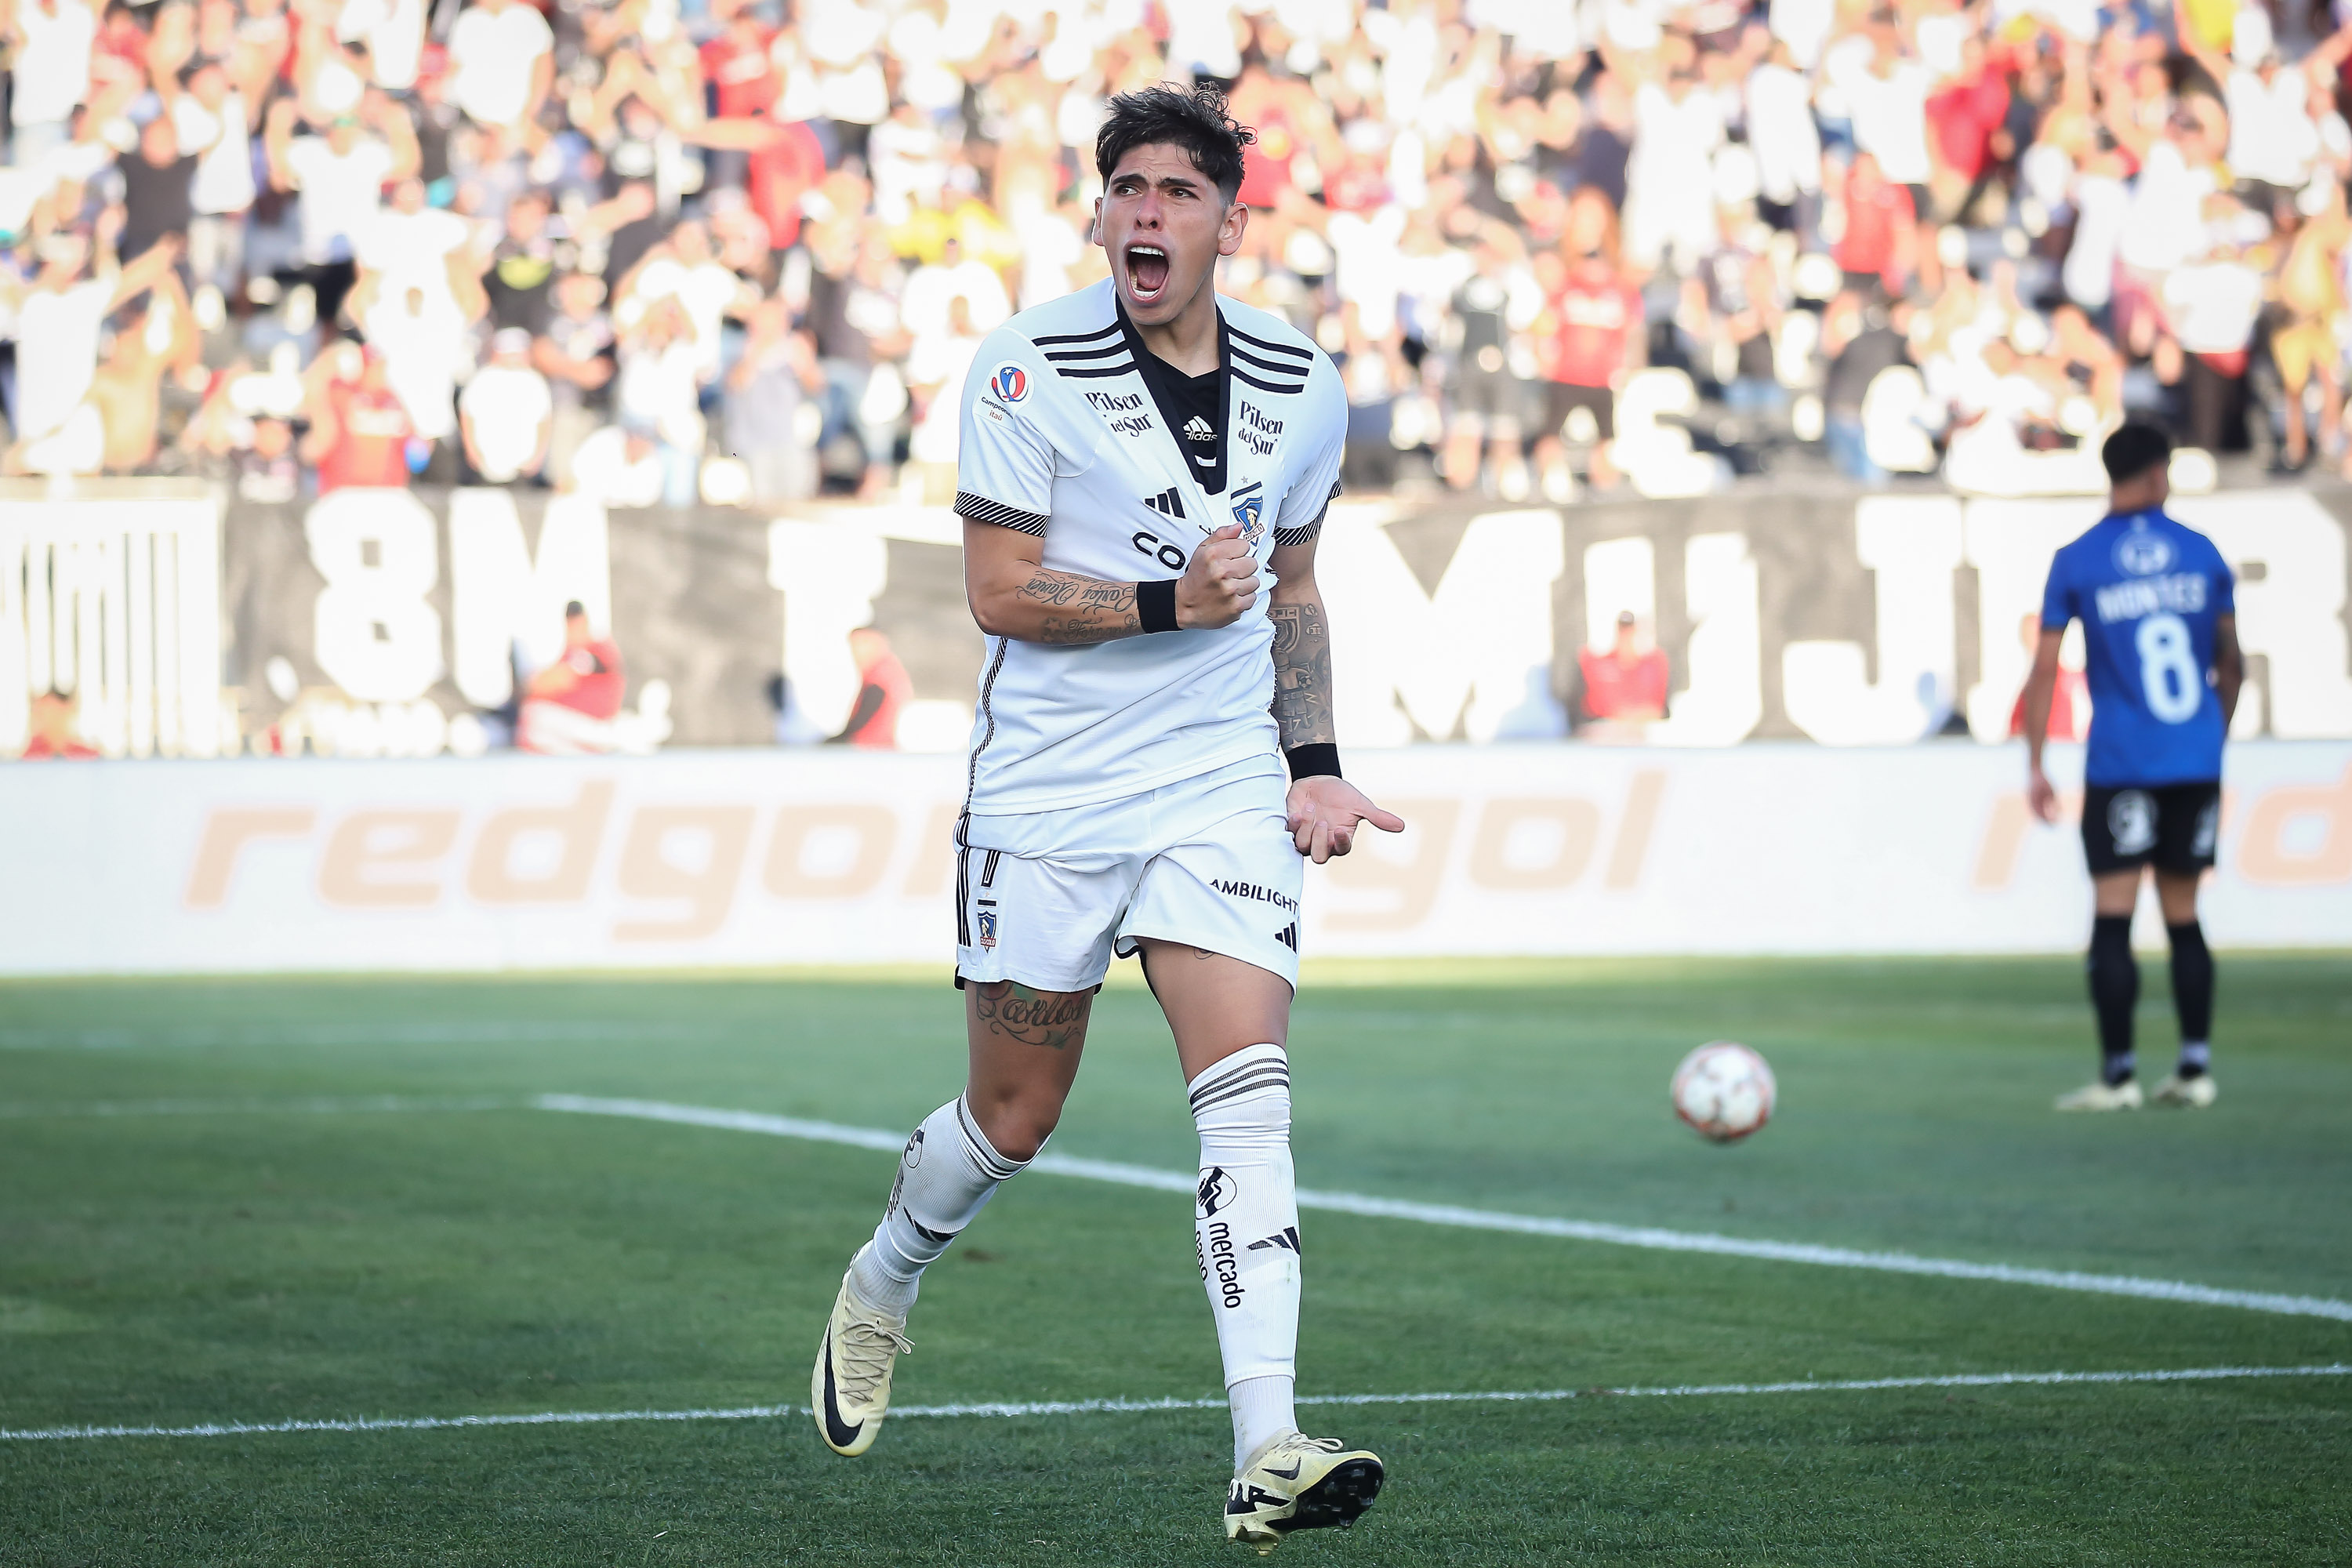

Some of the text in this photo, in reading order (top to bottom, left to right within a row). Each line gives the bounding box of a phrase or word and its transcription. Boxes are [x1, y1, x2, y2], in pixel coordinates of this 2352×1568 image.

[981, 397, 1014, 419] Campeon
[989, 410, 1004, 421] itaú
[1083, 391, 1144, 412] Pilsen
[1239, 399, 1283, 435] Pilsen
[1123, 413, 1154, 437] Sur
[1185, 430, 1218, 441] didas
[1238, 428, 1278, 456] del Sur
[1132, 532, 1191, 573] CO
[2135, 612, 2201, 726] 8
[1321, 768, 1668, 933] gol
[1209, 879, 1298, 915] AMBILIGHT
[1208, 1221, 1246, 1308] mercado
